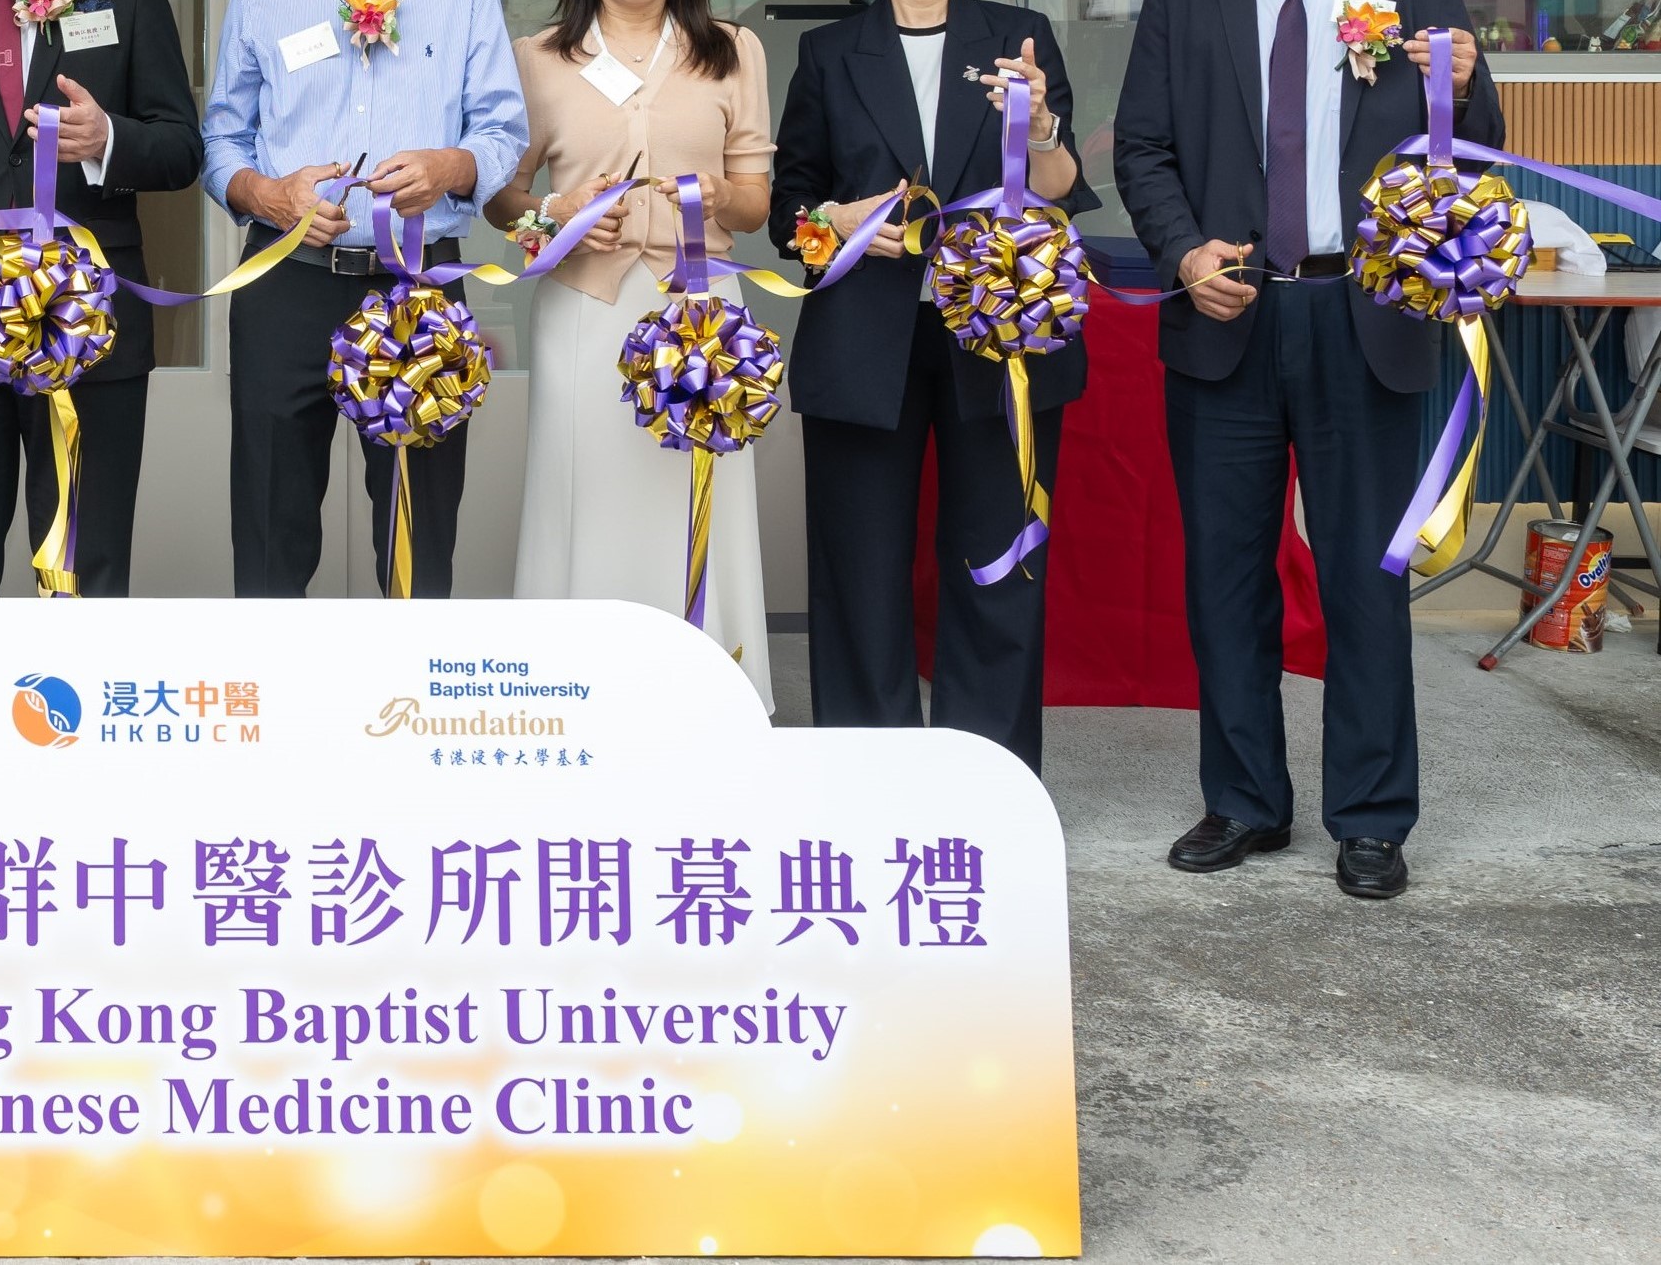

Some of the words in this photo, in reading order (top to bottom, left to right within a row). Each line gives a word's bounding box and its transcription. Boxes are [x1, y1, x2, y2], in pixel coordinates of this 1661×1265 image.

[429, 658, 476, 676] Hong
[482, 658, 529, 676] Kong
[102, 679, 260, 719] 浸大中醫
[429, 681, 494, 700] Baptist
[500, 681, 591, 700] University
[364, 697, 566, 737] Foundation
[430, 748, 594, 766] 香港浸會大學基金
[34, 986, 218, 1061] Kong
[239, 986, 477, 1061] Baptist
[499, 986, 848, 1061] University
[162, 1076, 473, 1136] Medicine
[495, 1076, 694, 1136] Clinic
